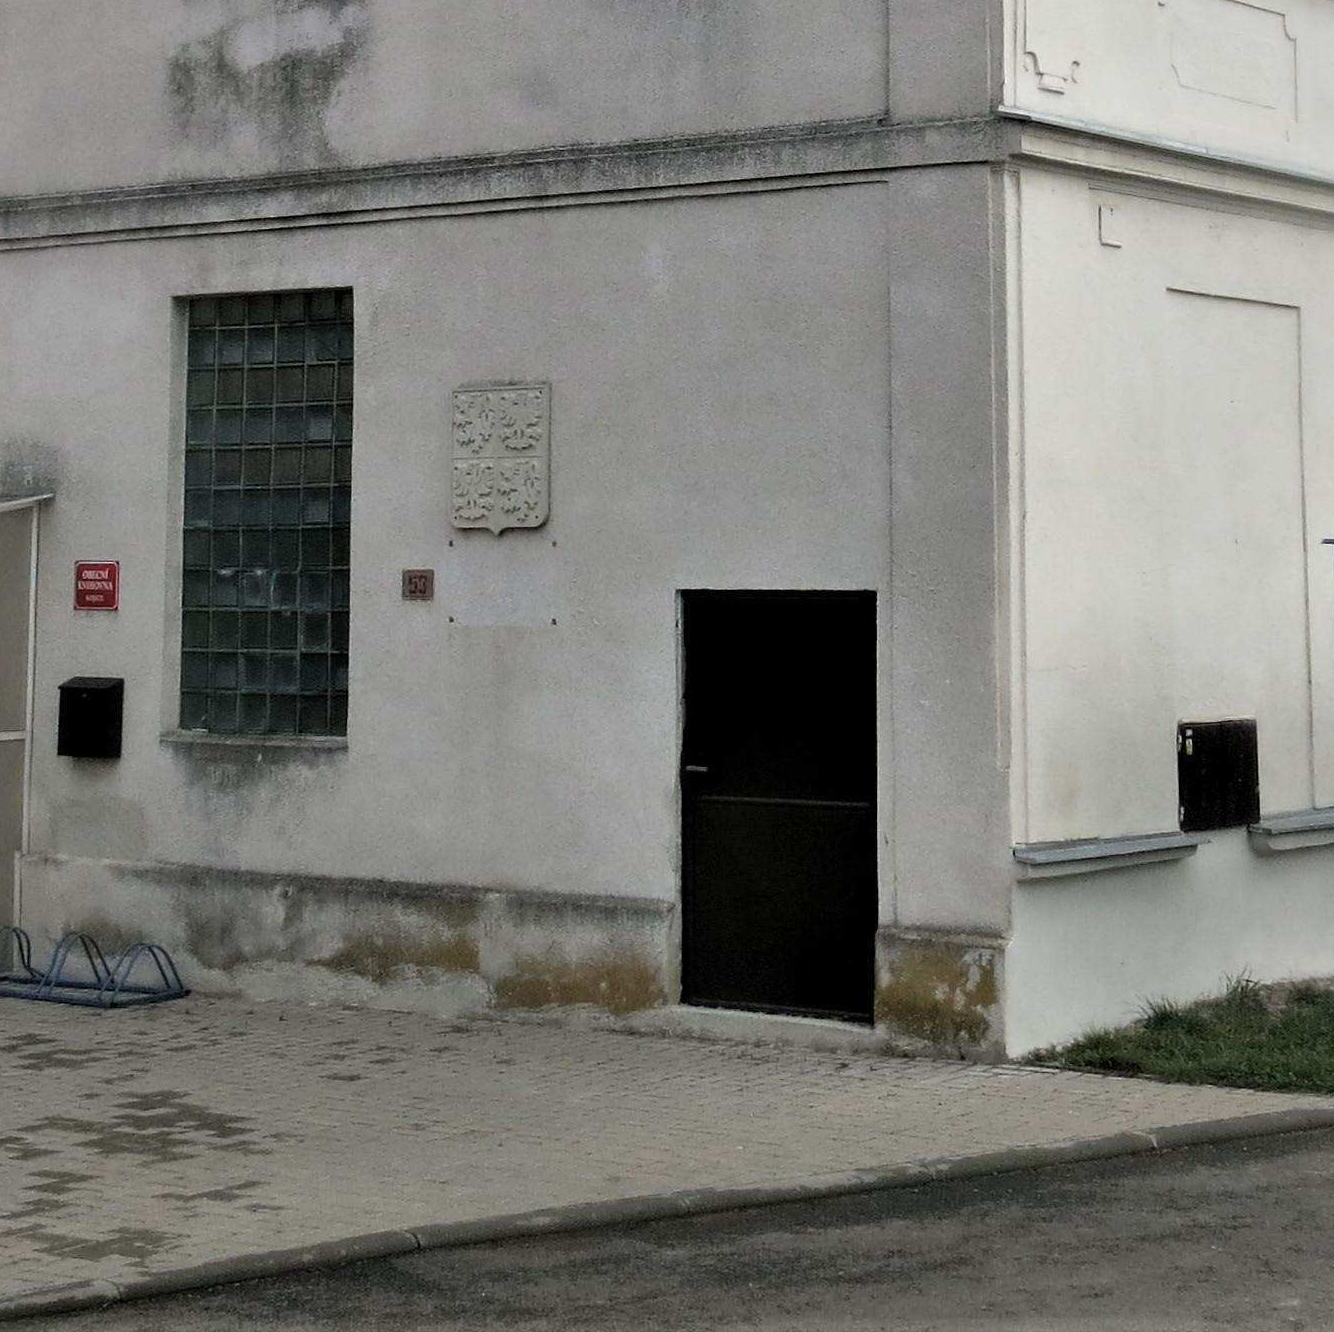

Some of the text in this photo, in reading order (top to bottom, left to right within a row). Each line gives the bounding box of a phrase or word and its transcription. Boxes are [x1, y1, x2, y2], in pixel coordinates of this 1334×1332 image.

[82, 568, 109, 580] OBECNÍ
[78, 580, 113, 591] KNIHOVNA
[408, 574, 428, 594] 53
